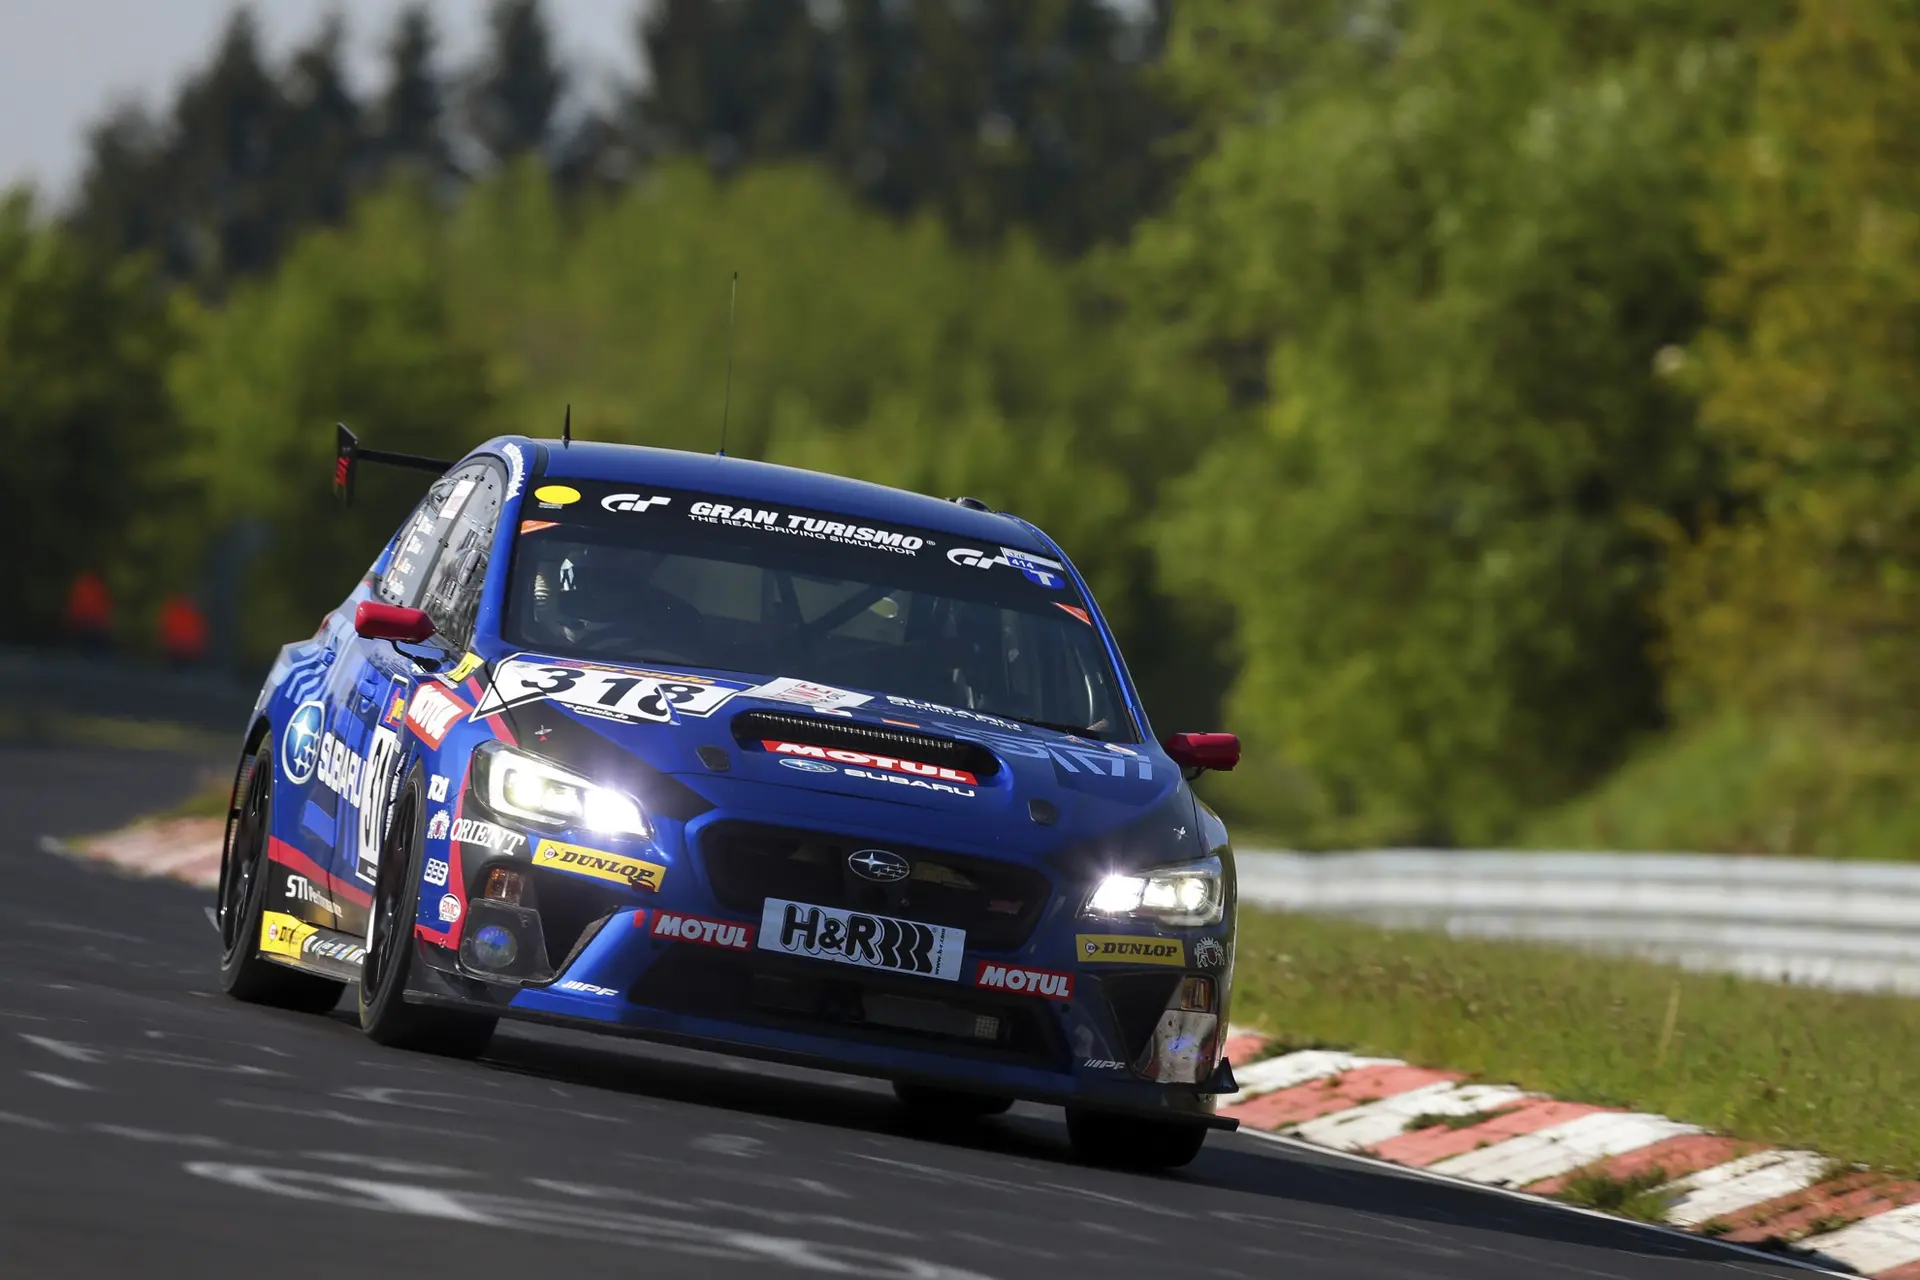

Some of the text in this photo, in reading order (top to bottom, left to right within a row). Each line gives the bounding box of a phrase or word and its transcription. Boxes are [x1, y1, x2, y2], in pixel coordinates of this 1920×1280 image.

[688, 514, 916, 556] THE REAL DRIVING SIMULATOR
[690, 502, 923, 550] GRAN TURISMO
[1011, 558, 1034, 570] 414
[1029, 569, 1055, 587] T
[521, 667, 705, 717] 318
[885, 695, 1021, 728] SUBARU
[317, 731, 368, 809] SUBARU
[775, 743, 967, 782] MOTUL
[844, 768, 976, 798] SUBARU
[450, 817, 527, 856] ORIENT
[559, 851, 655, 879] DUNLOP
[285, 874, 308, 901] STI
[654, 915, 749, 949] MOTUL
[781, 903, 876, 962] H&R
[1101, 942, 1177, 958] DUNLOP
[981, 966, 1071, 998] MOTUL
